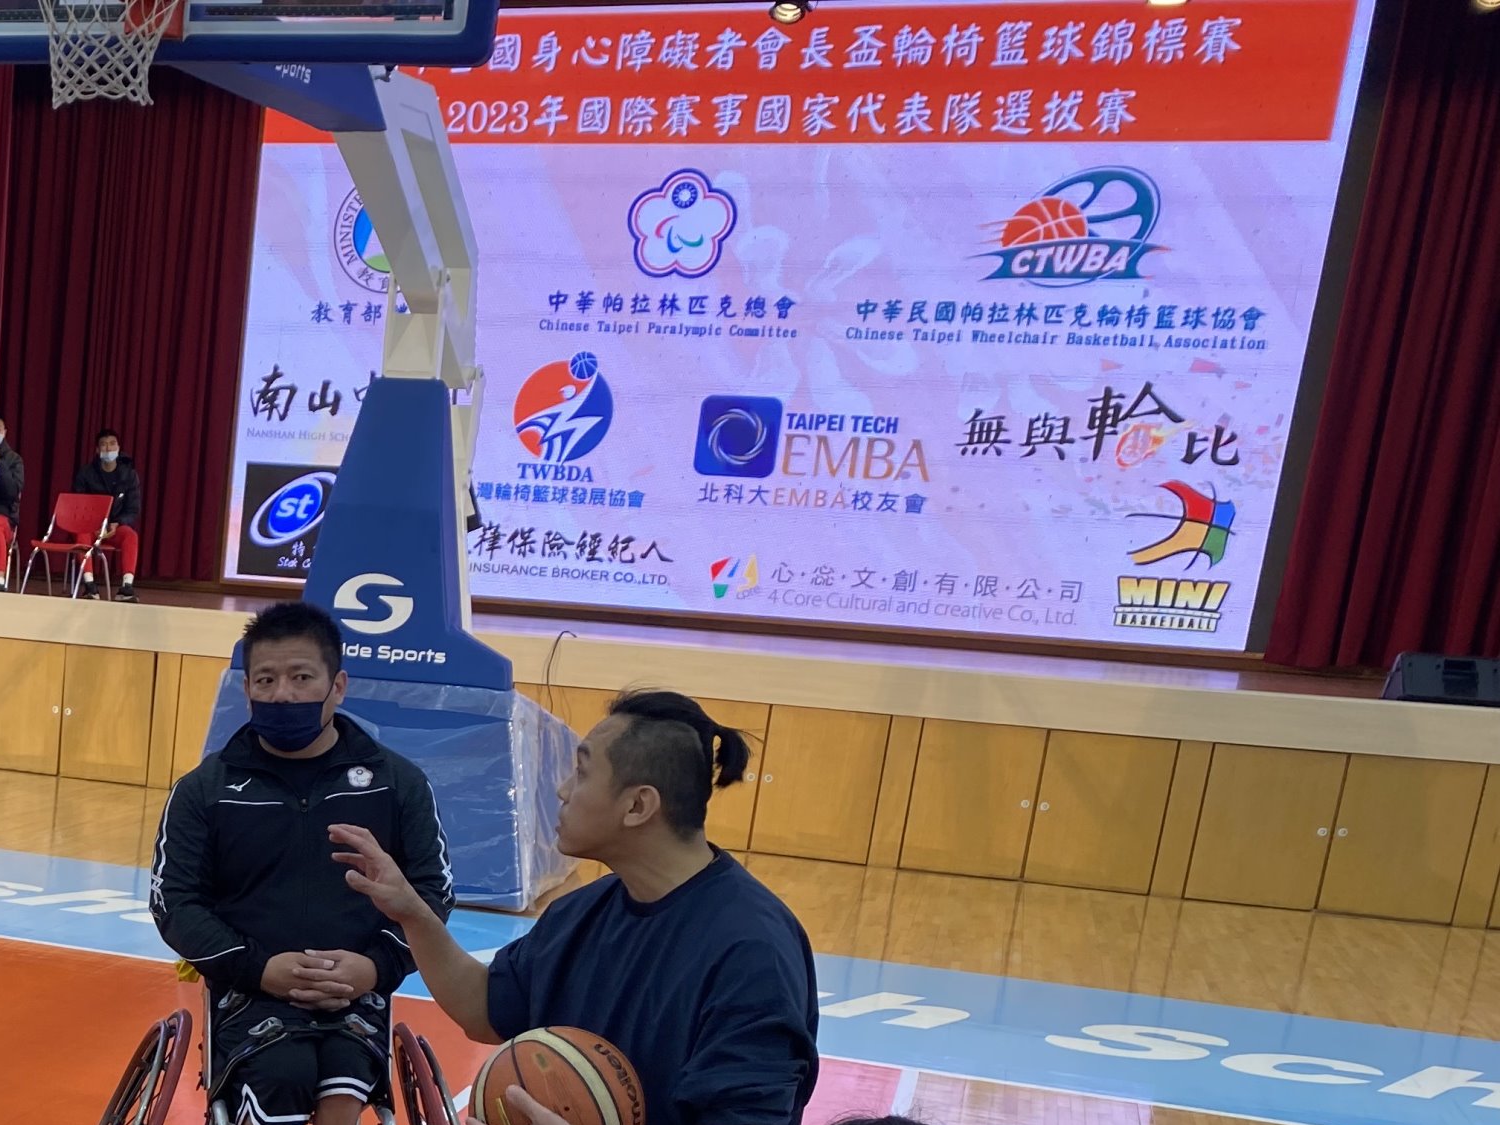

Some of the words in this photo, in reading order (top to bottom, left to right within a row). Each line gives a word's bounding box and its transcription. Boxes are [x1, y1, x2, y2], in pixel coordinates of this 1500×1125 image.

[417, 16, 1242, 73] 國身心障礙者會長盃輪椅籃球錦標賽
[446, 87, 1138, 137] 2023年國際賽事國家代表隊選拔賽
[1011, 244, 1132, 276] CTWBA
[311, 300, 383, 326] 教育部
[548, 289, 797, 320] 中華帕拉林匹克總會
[856, 299, 1267, 332] 中華民國帕拉林匹克輪椅籃球協會
[539, 318, 590, 333] Chinese
[597, 319, 640, 335] Taipei
[647, 321, 722, 338] Paralympic
[729, 324, 798, 339] Committee
[845, 326, 903, 342] Chinese
[912, 328, 962, 345] Taipei
[971, 329, 1057, 346] Wheelchair
[1066, 331, 1155, 348] Basketball
[1164, 334, 1267, 351] Association
[786, 412, 845, 432] TAIPEI
[851, 415, 900, 434] TECH
[517, 463, 594, 483] TWBDA
[781, 433, 931, 482] EMBA
[697, 482, 928, 514] 北科大EMBA校友會
[469, 563, 548, 578] INSURANCE
[552, 567, 609, 582] BROKER
[767, 591, 780, 606] 4
[781, 591, 823, 608] Core
[826, 592, 895, 613] Cultural
[895, 595, 930, 616] and
[934, 600, 1003, 621] creative
[1044, 606, 1078, 626] Ltd.
[1118, 576, 1231, 611] MINI
[1120, 614, 1213, 631] BASKETBALL
[377, 645, 447, 665] Sports
